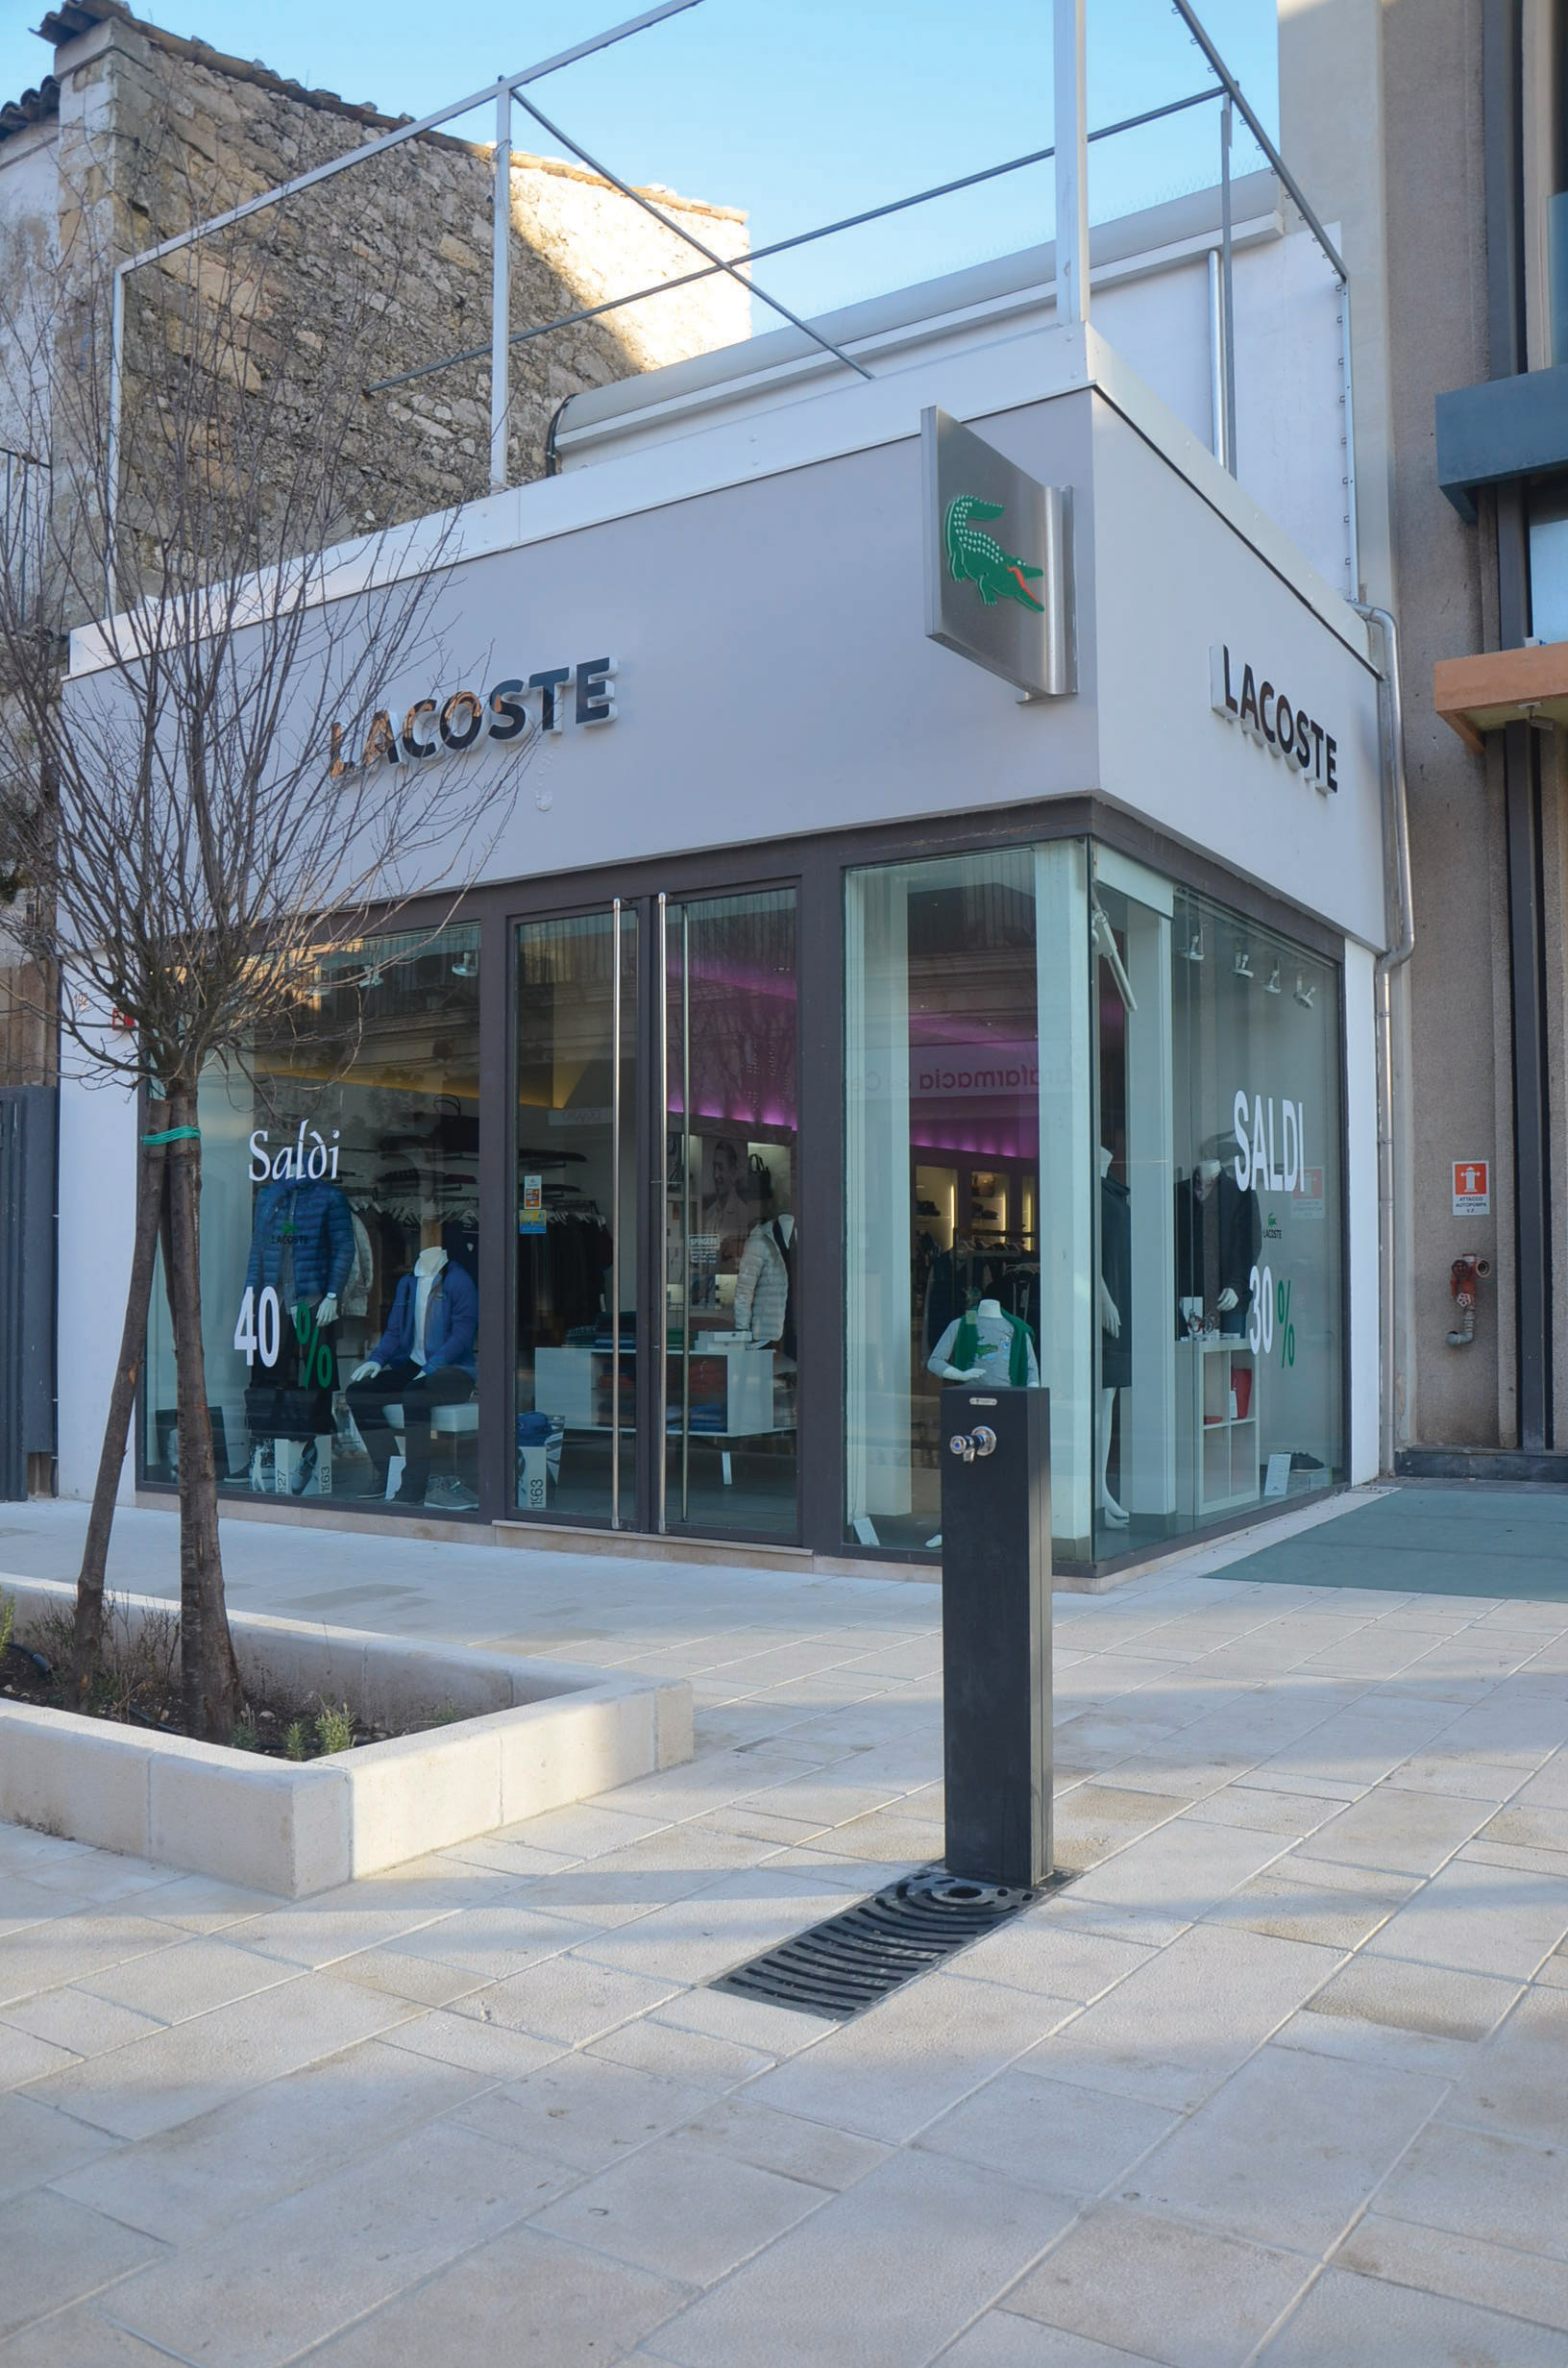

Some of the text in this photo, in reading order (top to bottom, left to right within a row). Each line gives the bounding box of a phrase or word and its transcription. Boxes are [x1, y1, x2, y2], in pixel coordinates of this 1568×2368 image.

[330, 656, 617, 777] LACOSTE
[1211, 644, 1338, 796] LACOSTE
[248, 1119, 340, 1182] Saldi
[1235, 1090, 1304, 1192] SALDI
[233, 1286, 280, 1368] 40
[1249, 1265, 1274, 1355] 30
